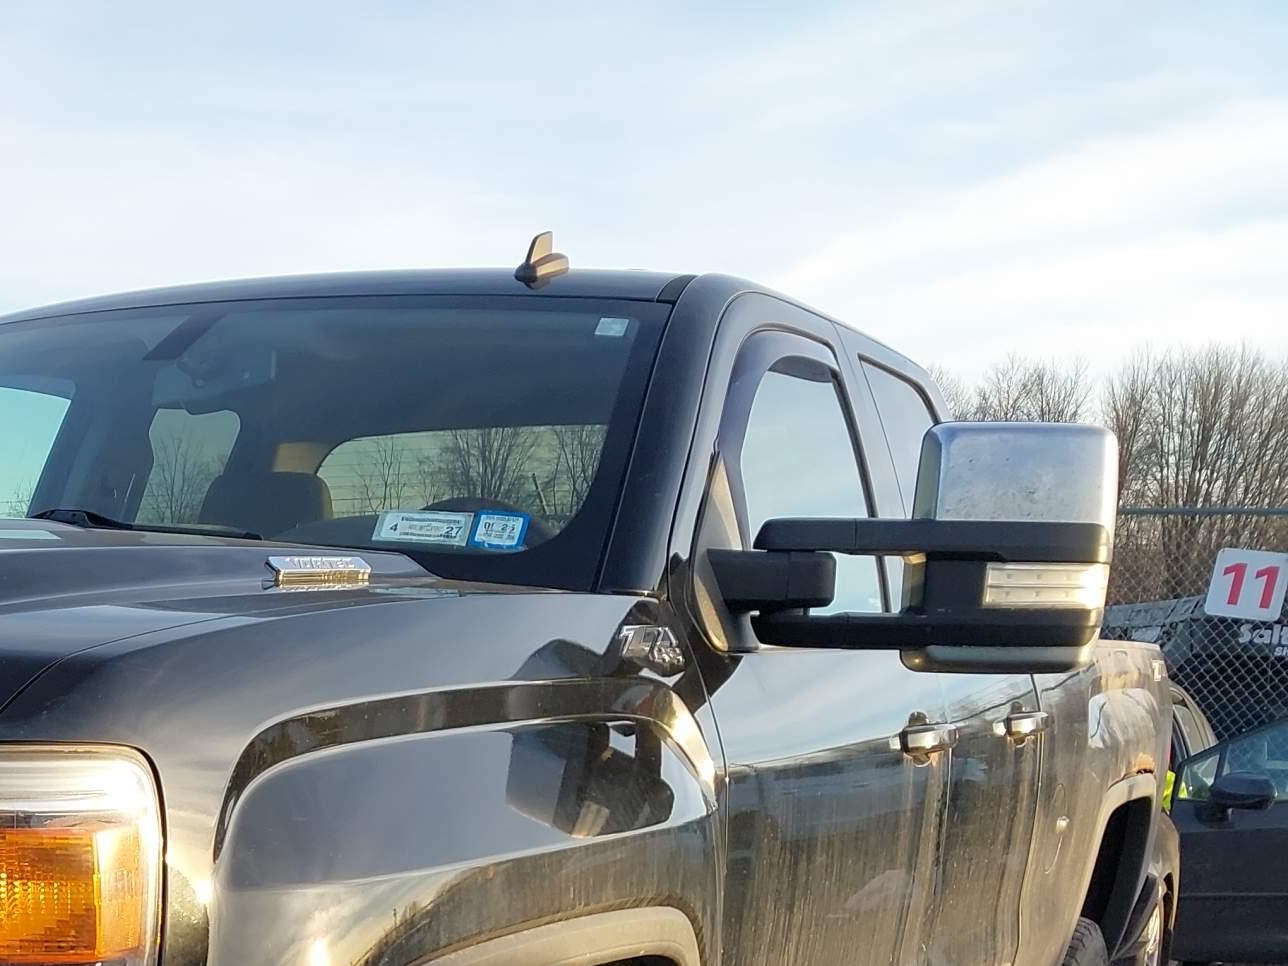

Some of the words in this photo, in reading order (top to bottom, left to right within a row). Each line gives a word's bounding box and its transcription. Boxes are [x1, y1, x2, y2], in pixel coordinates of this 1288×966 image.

[388, 522, 399, 533] 4
[445, 525, 463, 536] 27
[1223, 562, 1281, 609] 11
